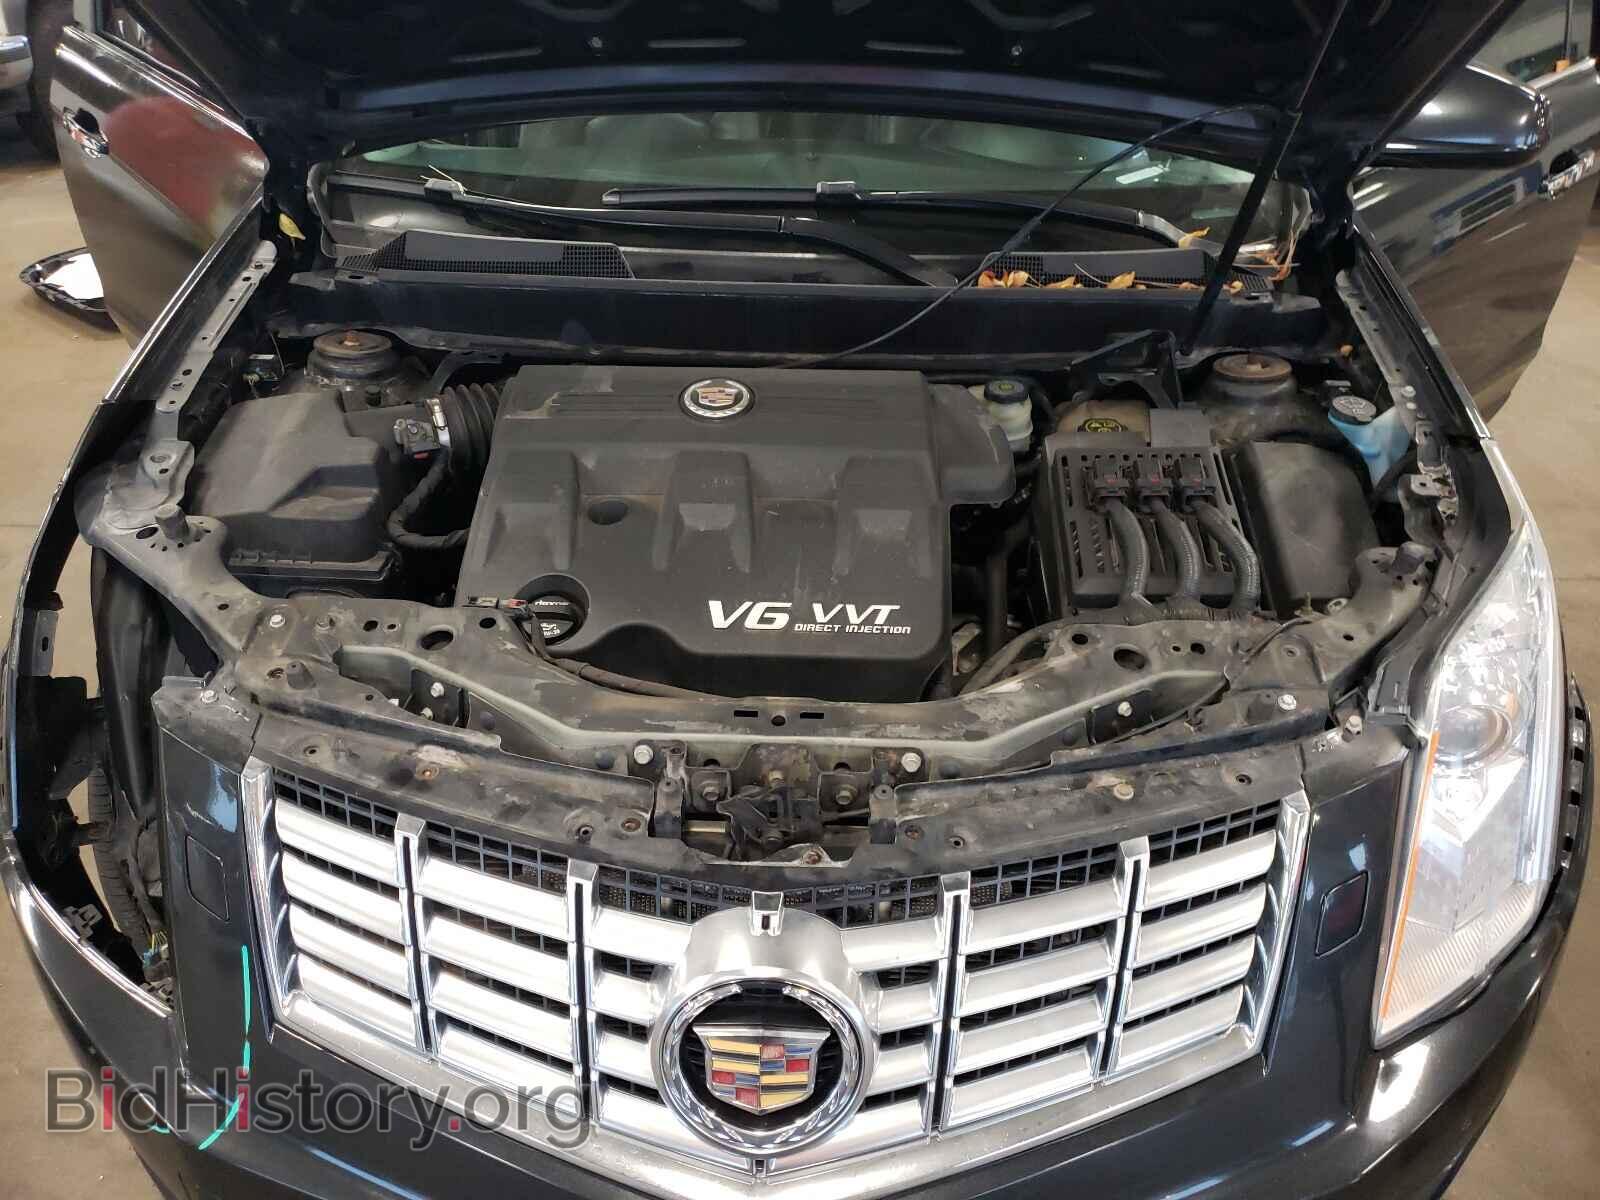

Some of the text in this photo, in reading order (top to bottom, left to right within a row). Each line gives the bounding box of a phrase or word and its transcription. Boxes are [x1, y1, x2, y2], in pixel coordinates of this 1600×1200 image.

[708, 600, 901, 630] V6 VVT
[794, 623, 912, 635] DIRECT INJECTION
